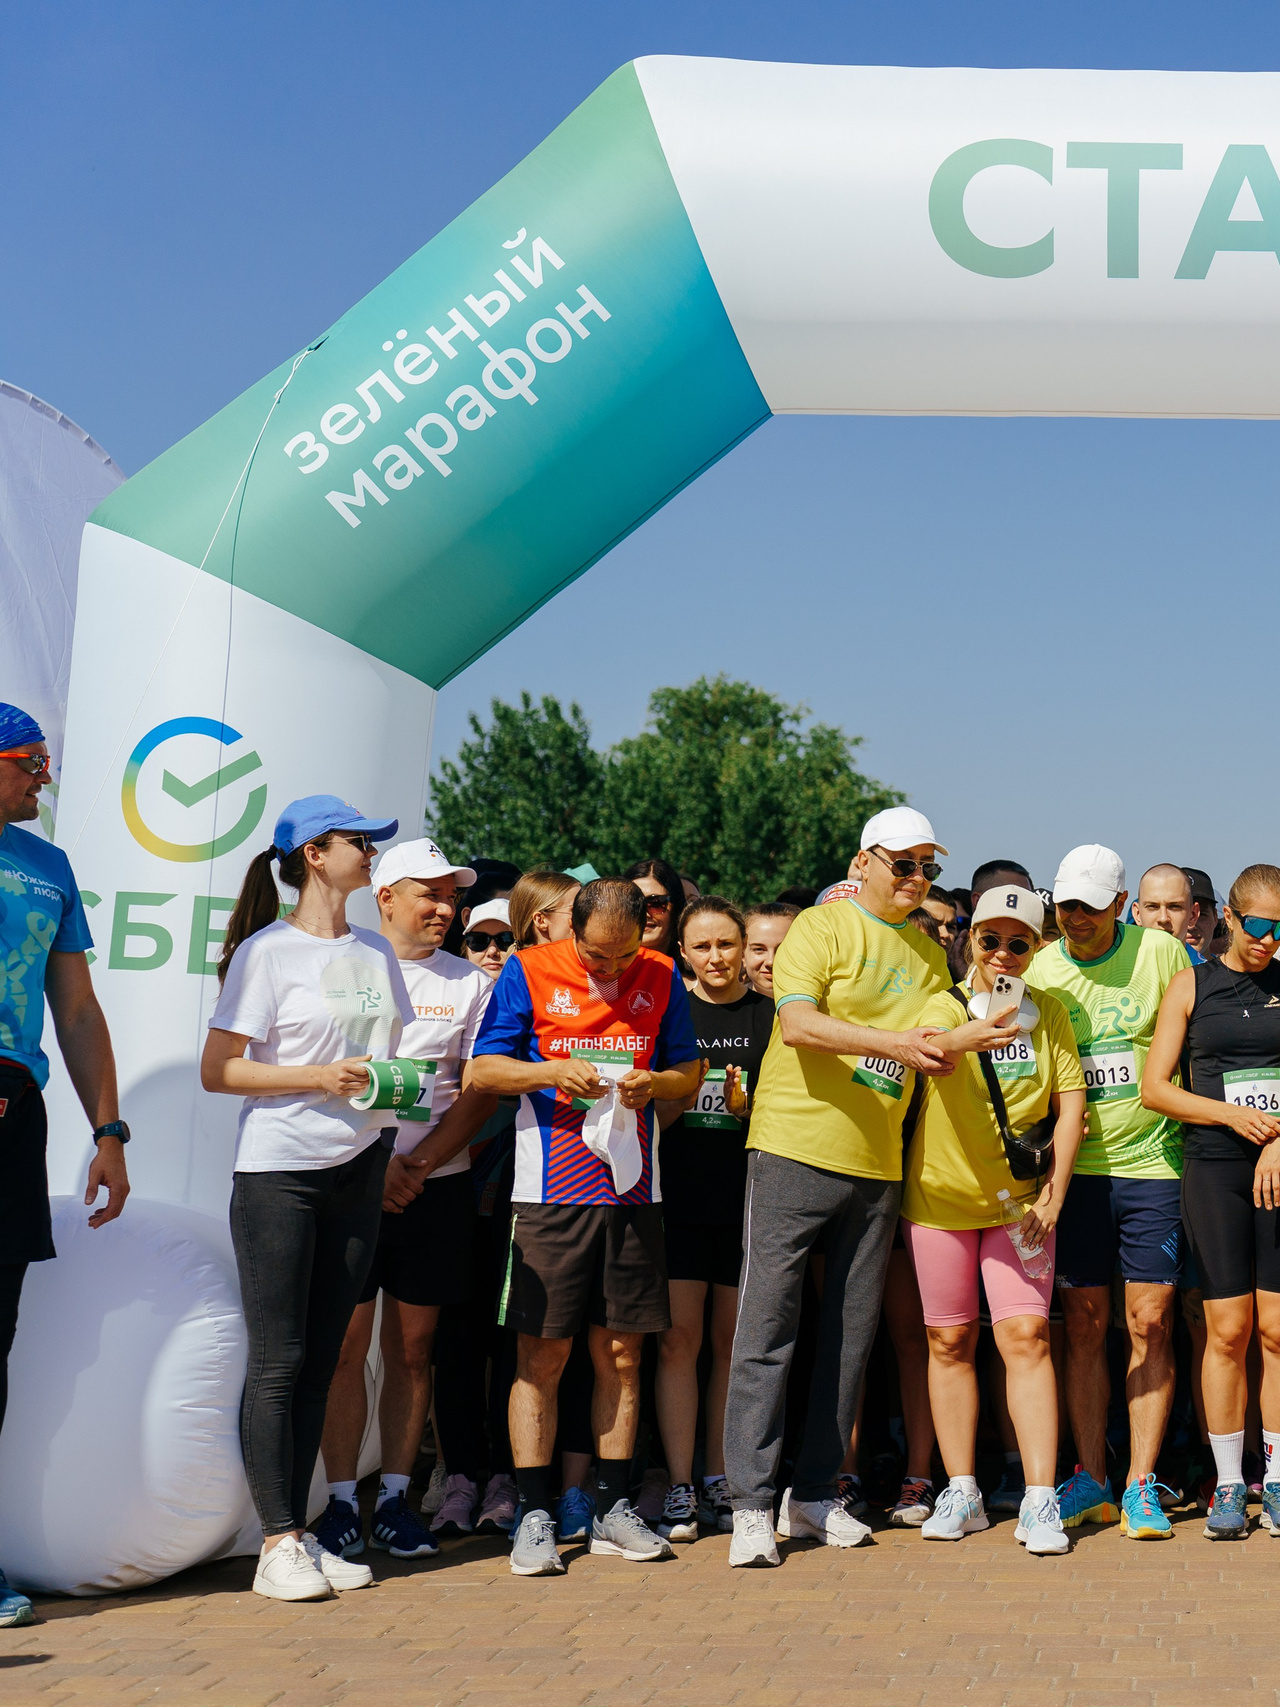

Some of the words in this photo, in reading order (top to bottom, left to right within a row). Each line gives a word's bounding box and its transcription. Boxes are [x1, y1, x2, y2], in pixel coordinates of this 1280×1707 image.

[284, 227, 566, 475] зелёный
[324, 284, 612, 529] марафон
[412, 1004, 455, 1017] ТРОЙ
[696, 1037, 750, 1048] ALANCE
[988, 1043, 1029, 1062] 008
[864, 1056, 905, 1083] 0002
[1084, 1065, 1130, 1087] 0013
[390, 1065, 405, 1105] СБЕР
[693, 1095, 731, 1113] 102
[1234, 1093, 1279, 1111] 1836
